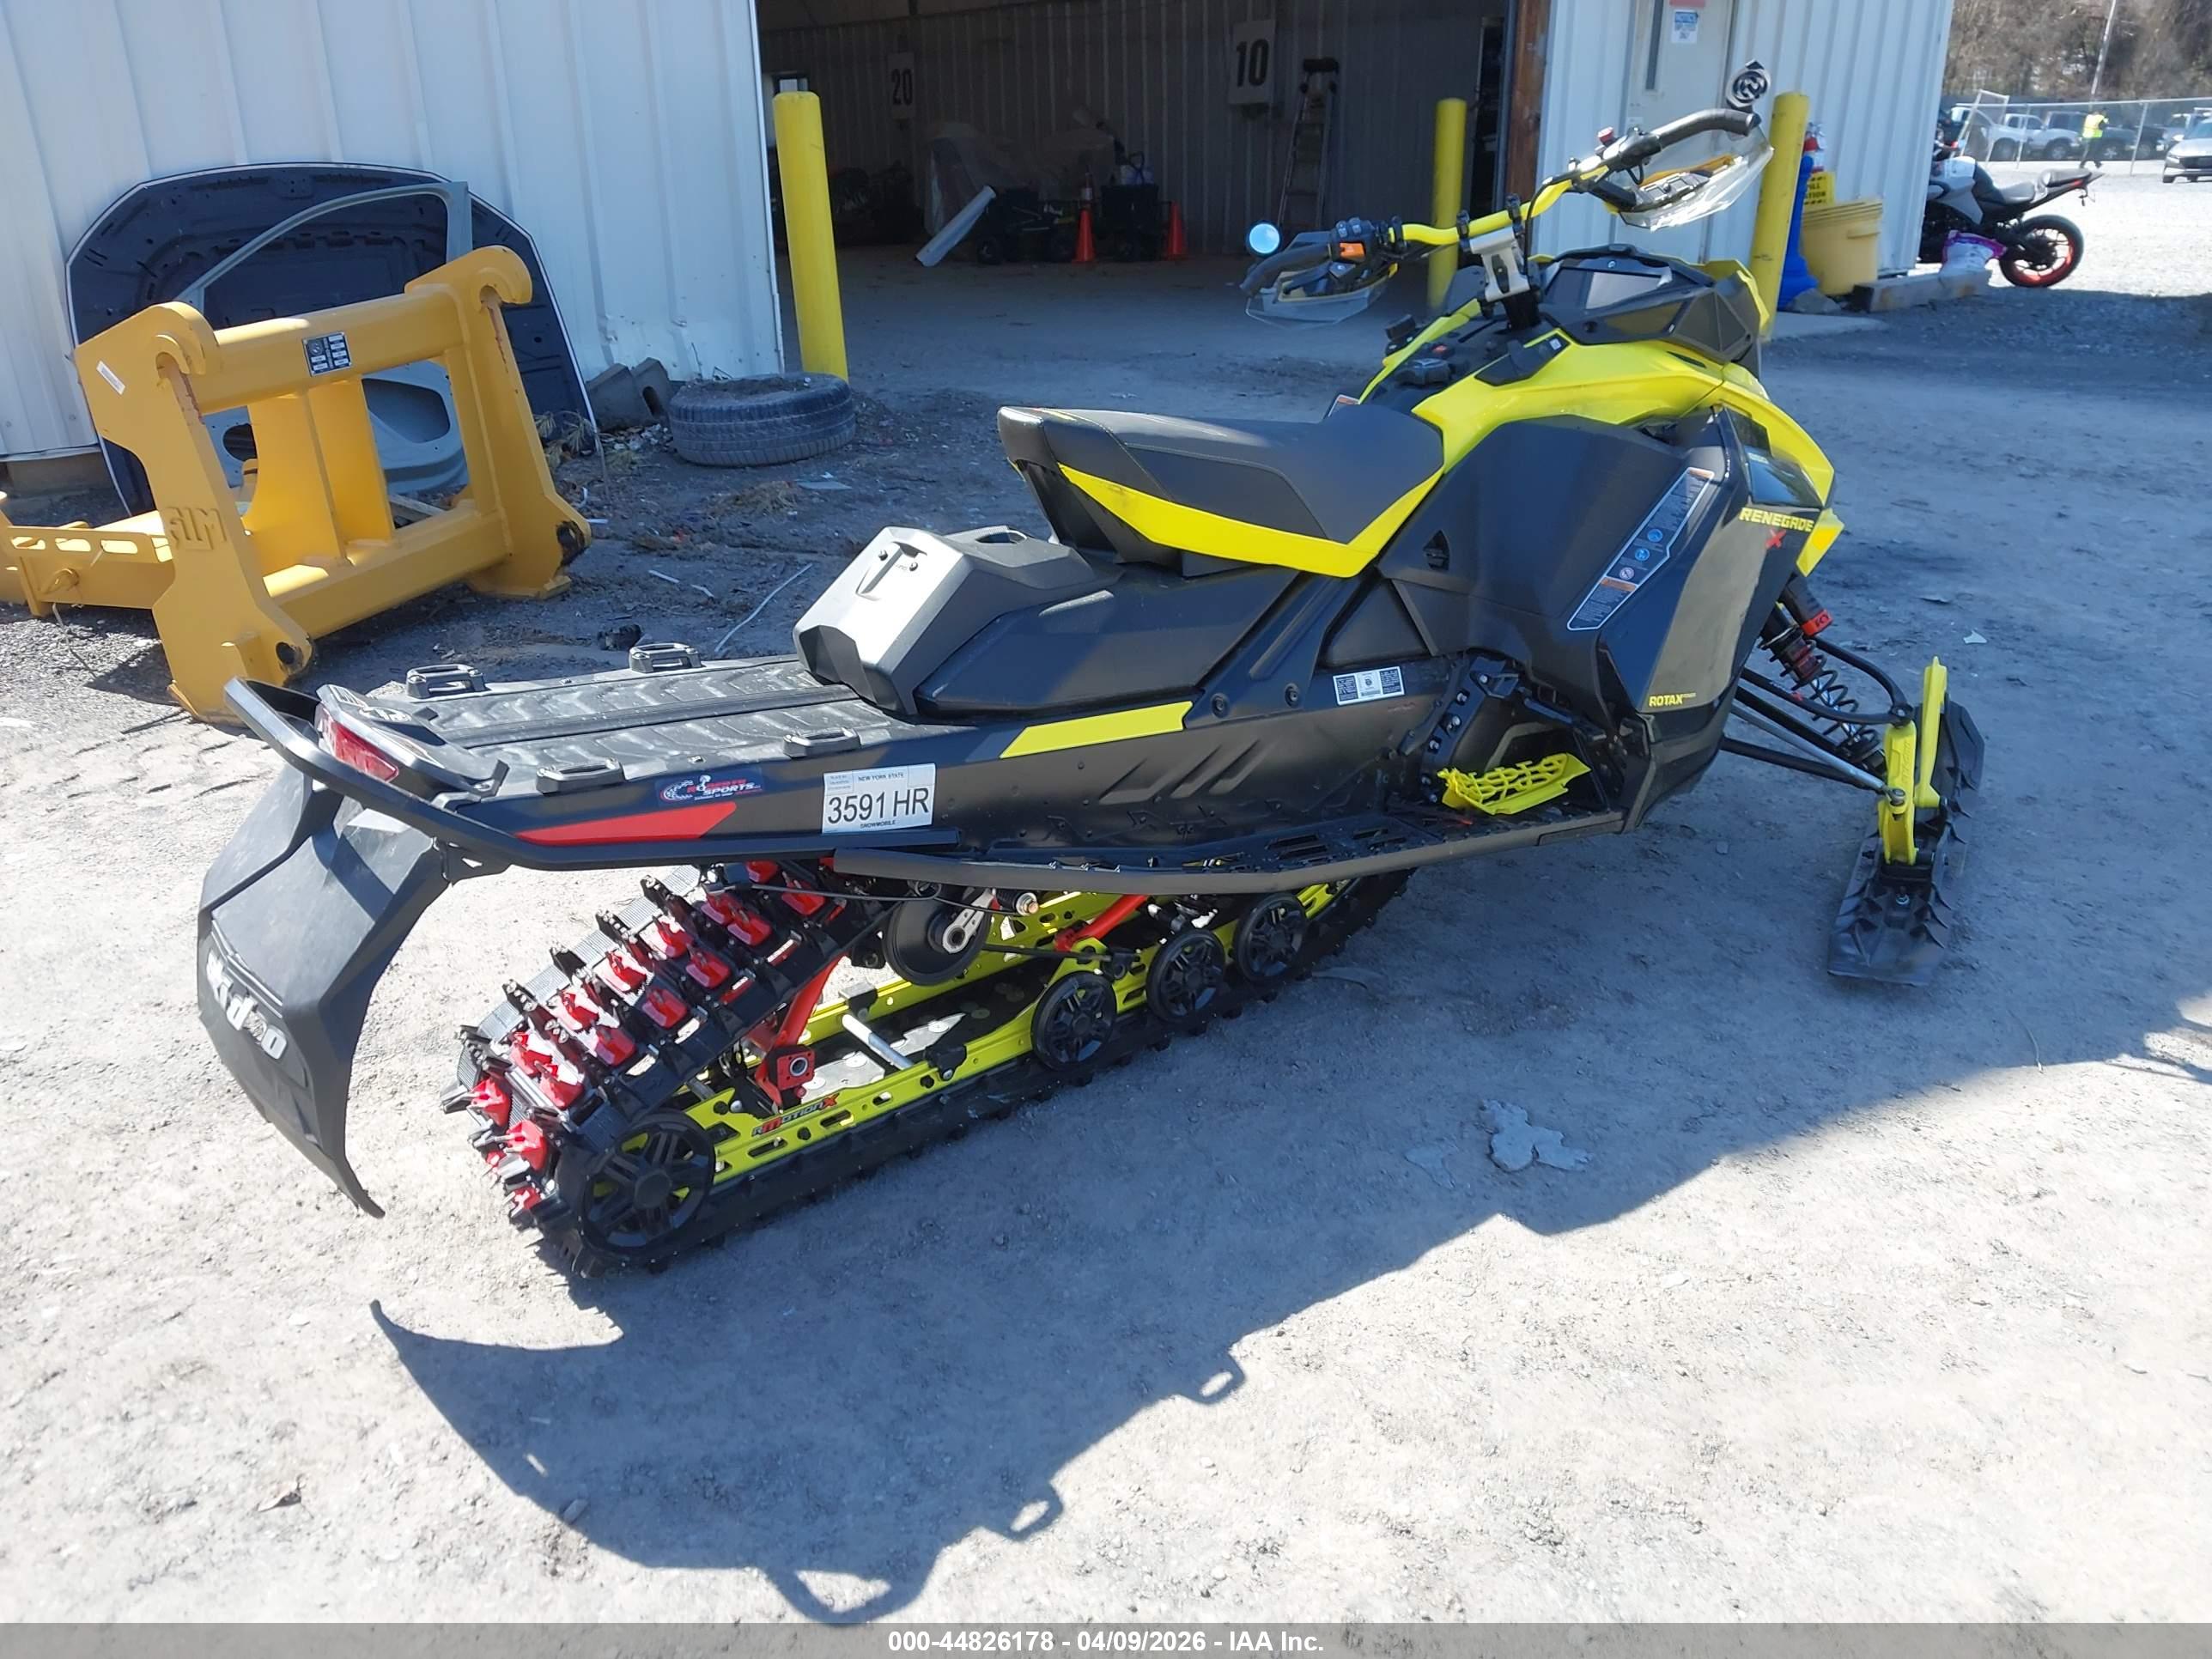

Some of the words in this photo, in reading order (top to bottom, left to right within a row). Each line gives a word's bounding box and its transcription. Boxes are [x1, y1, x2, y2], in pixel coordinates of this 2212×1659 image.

[1237, 40, 1269, 87] 10
[891, 69, 913, 105] 20
[1739, 507, 1814, 532] RENEGADE
[1765, 528, 1787, 548] X
[1649, 693, 1683, 708] ROTAX
[702, 782, 755, 796] SPORTS
[860, 819, 896, 830] SNOWMOBILE
